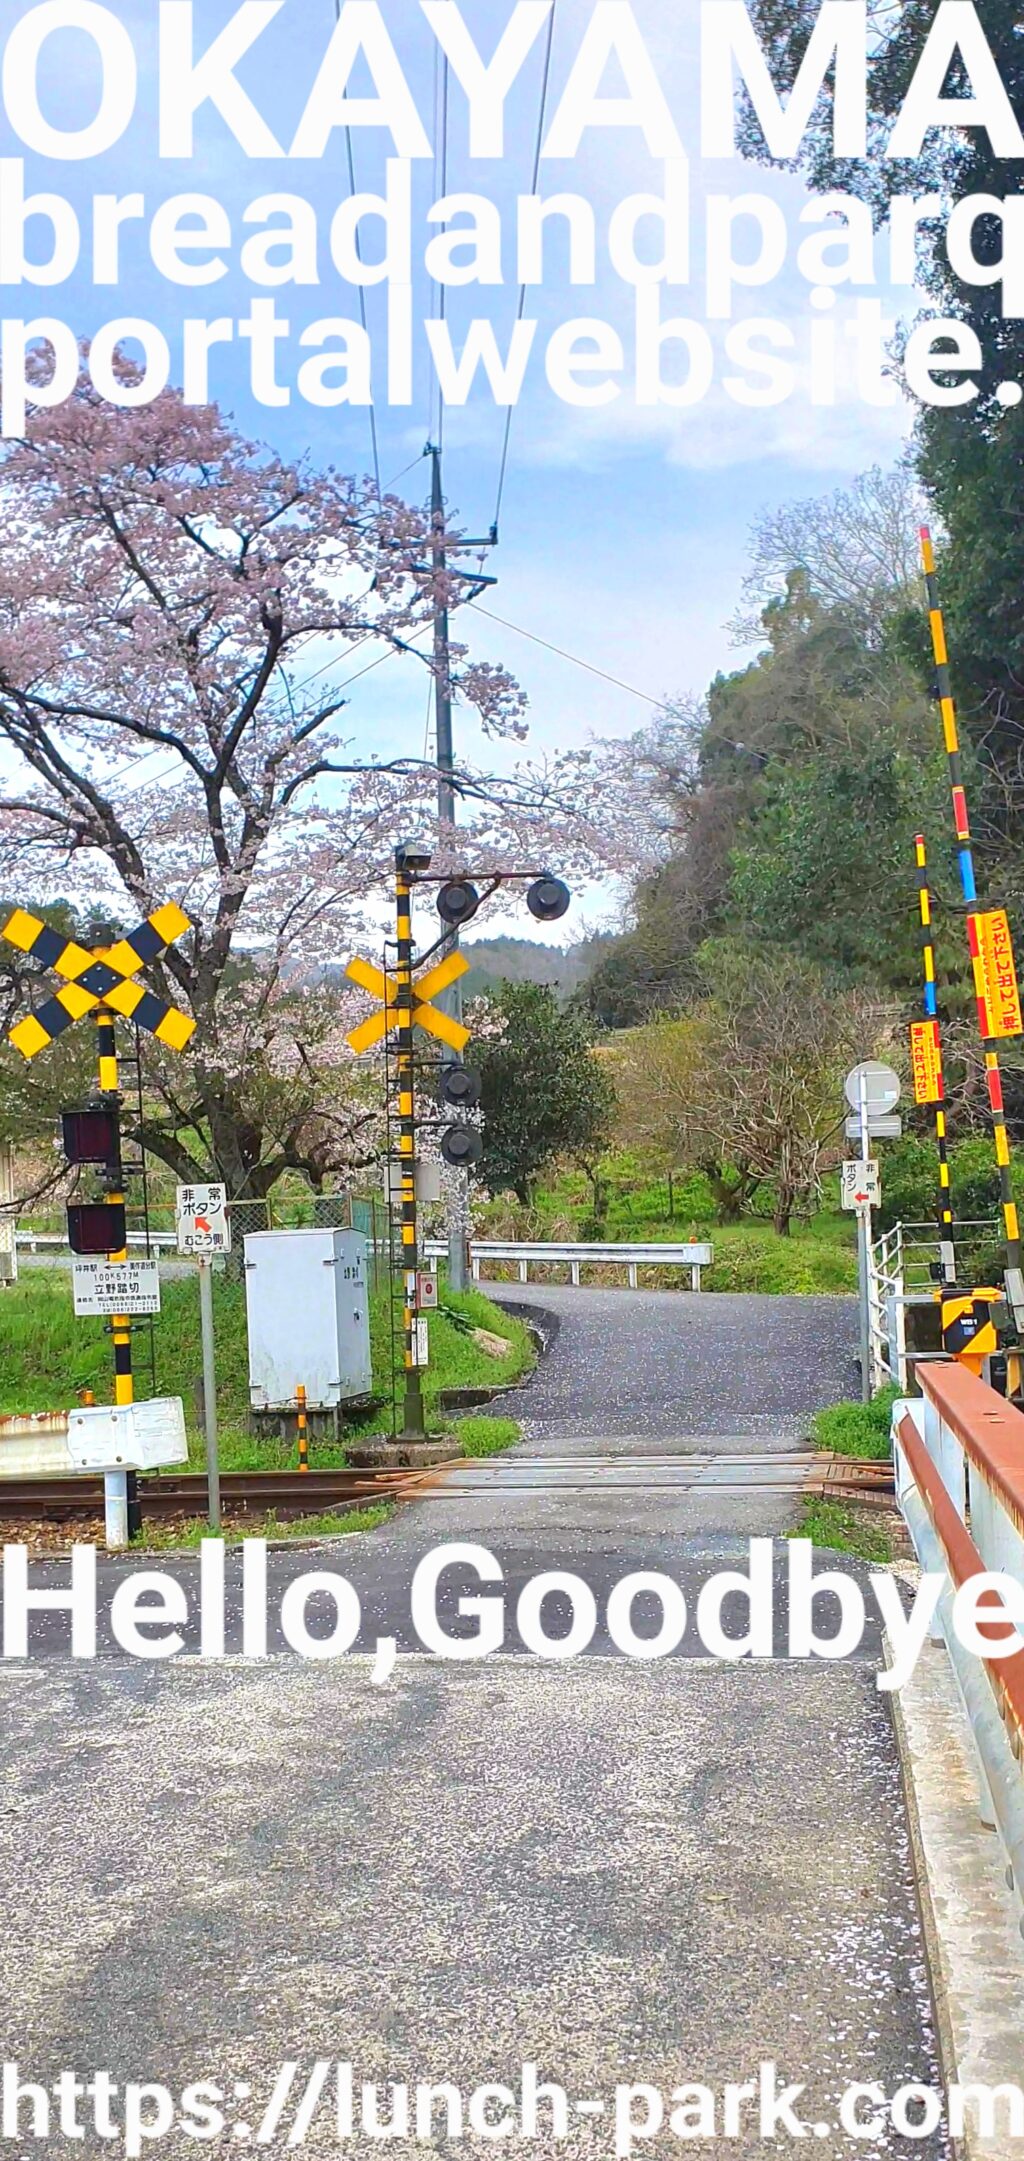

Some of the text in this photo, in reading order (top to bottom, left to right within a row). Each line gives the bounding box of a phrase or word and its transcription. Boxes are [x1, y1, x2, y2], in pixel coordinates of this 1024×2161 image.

[991, 916, 1020, 1031] 押して出て下さい
[846, 1164, 857, 1192] ボタン
[182, 1187, 222, 1202] 非常
[183, 1202, 222, 1216] ボタン
[184, 1233, 224, 1246] むこう側
[94, 1282, 140, 1295] 立野踏切
